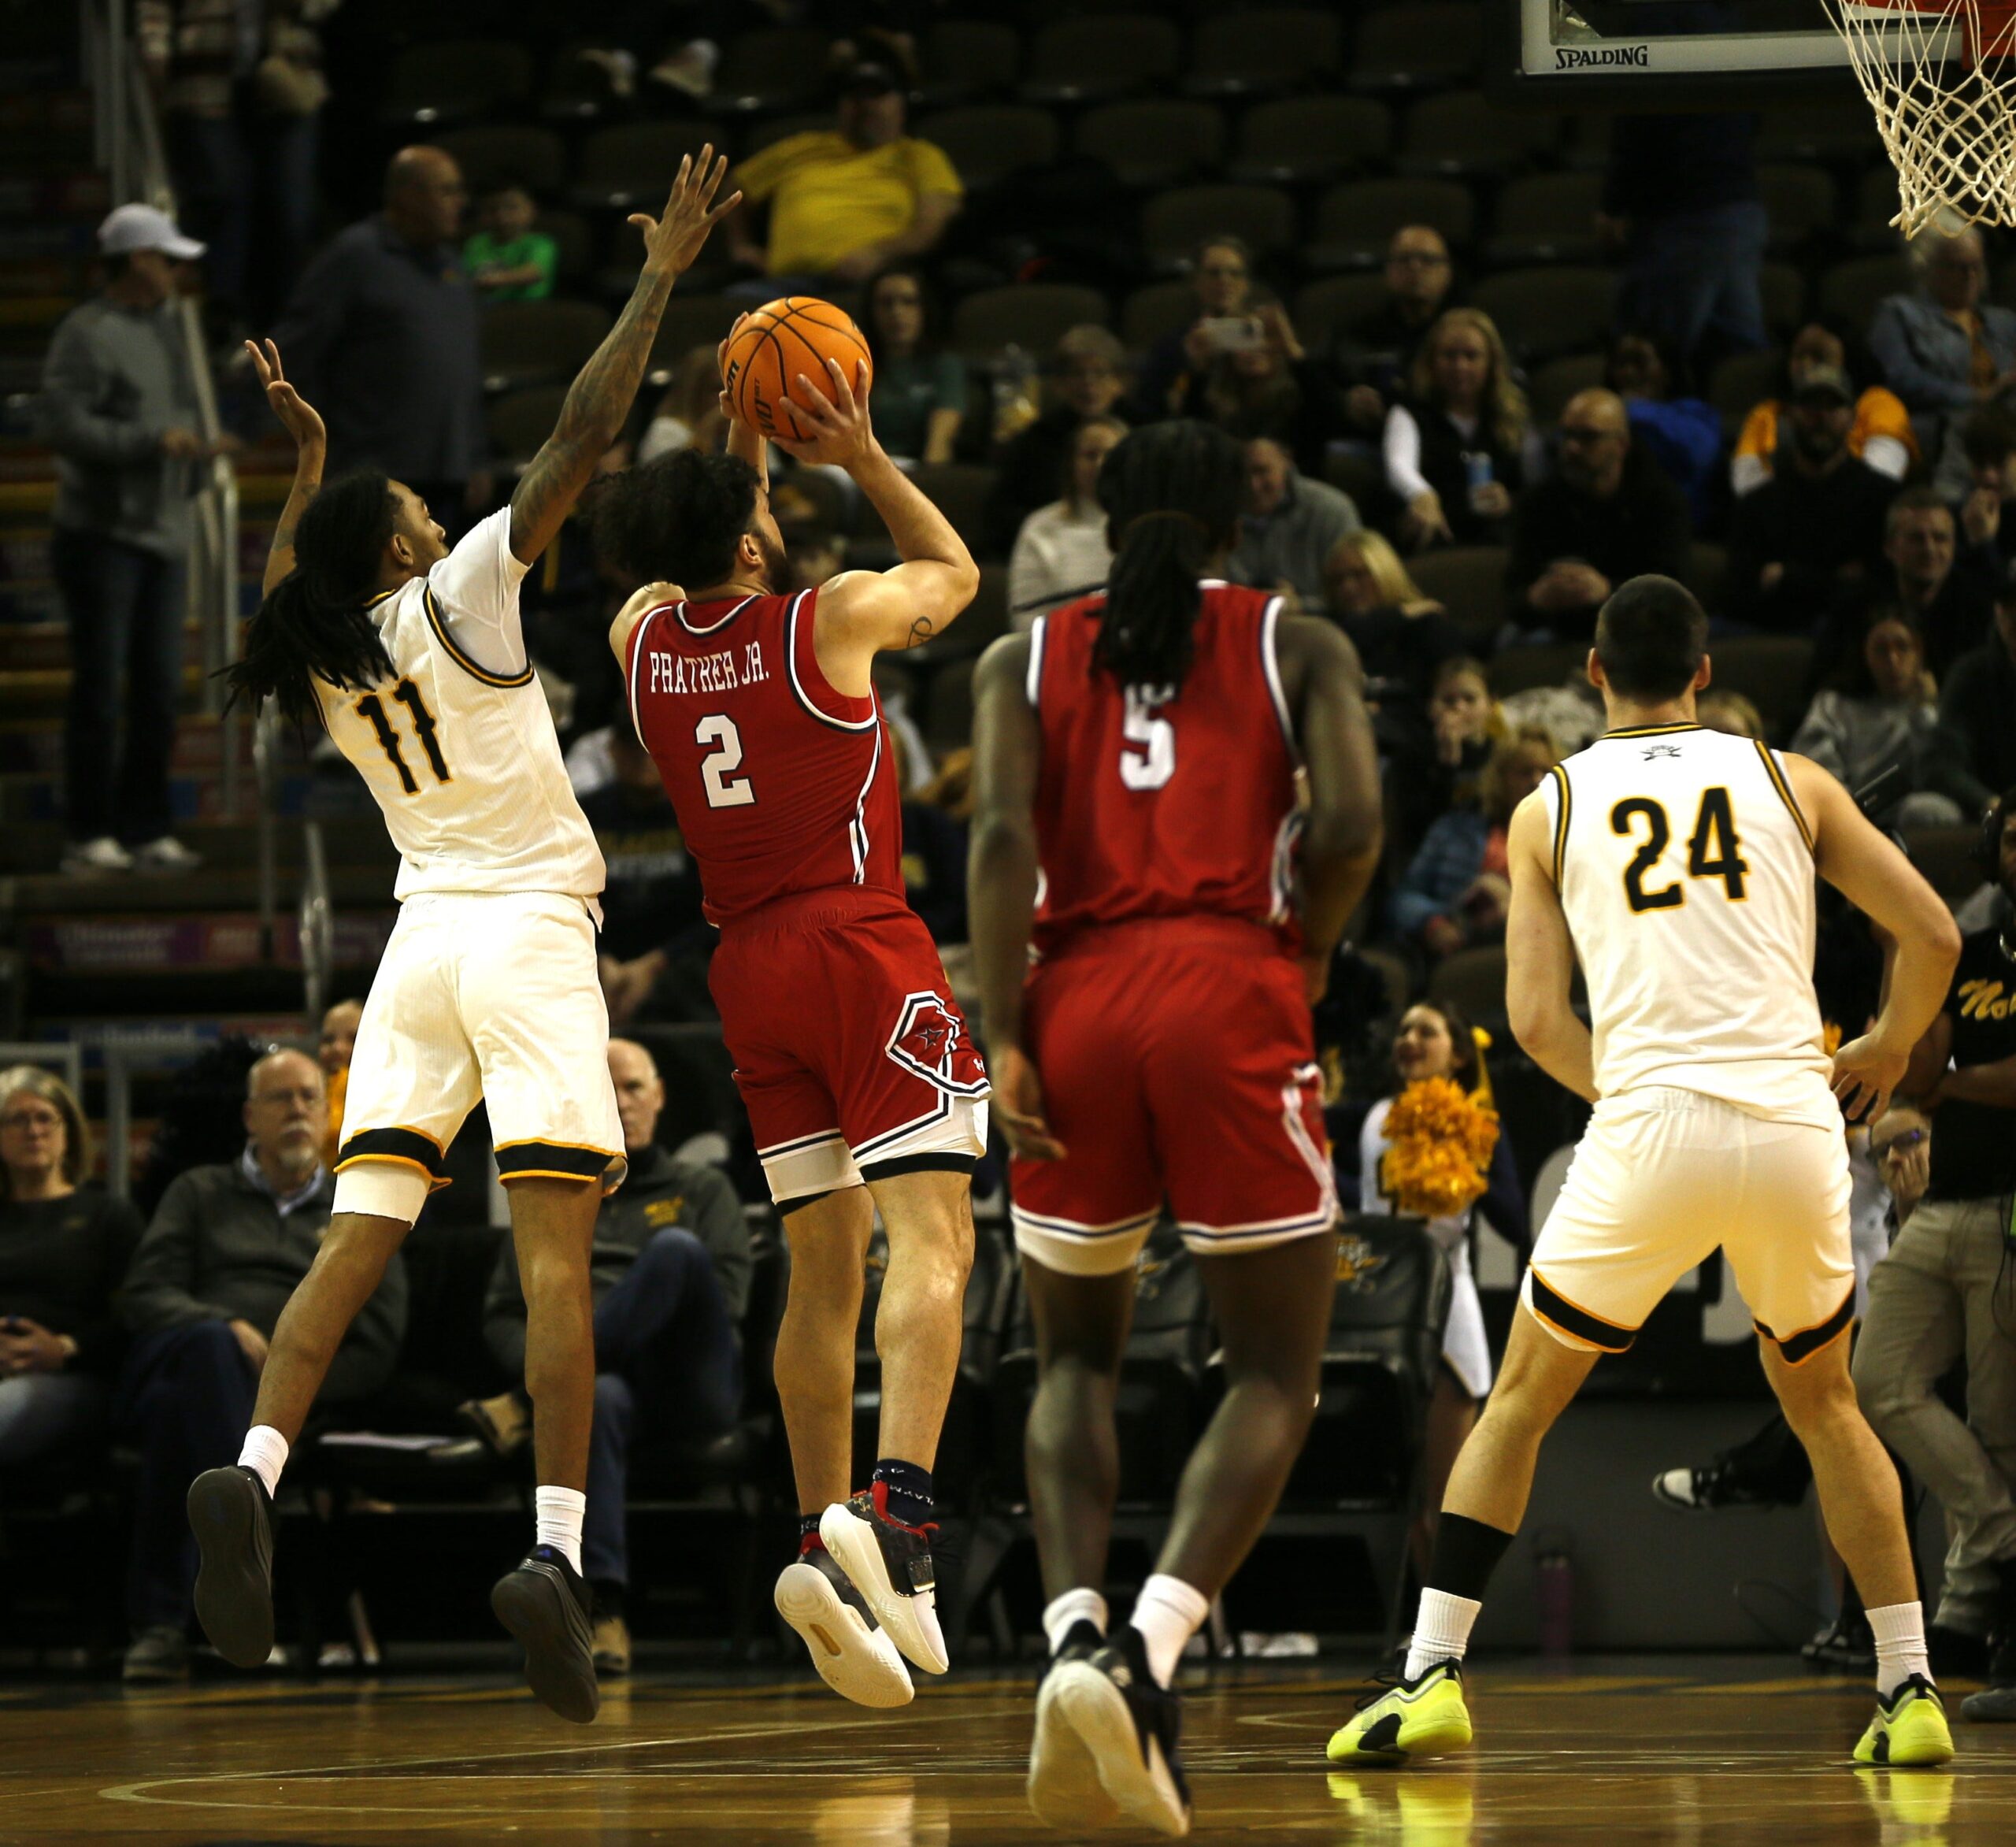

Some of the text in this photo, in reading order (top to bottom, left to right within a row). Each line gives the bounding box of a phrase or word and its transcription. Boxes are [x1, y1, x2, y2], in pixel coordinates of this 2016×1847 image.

[1555, 45, 1648, 69] SPALDING
[649, 640, 769, 694] PRATHER JR.
[354, 675, 453, 796] 11
[695, 712, 757, 809] 2
[1119, 681, 1176, 792] 5
[1610, 785, 1750, 914] 24
[1958, 977, 2016, 1022] No
